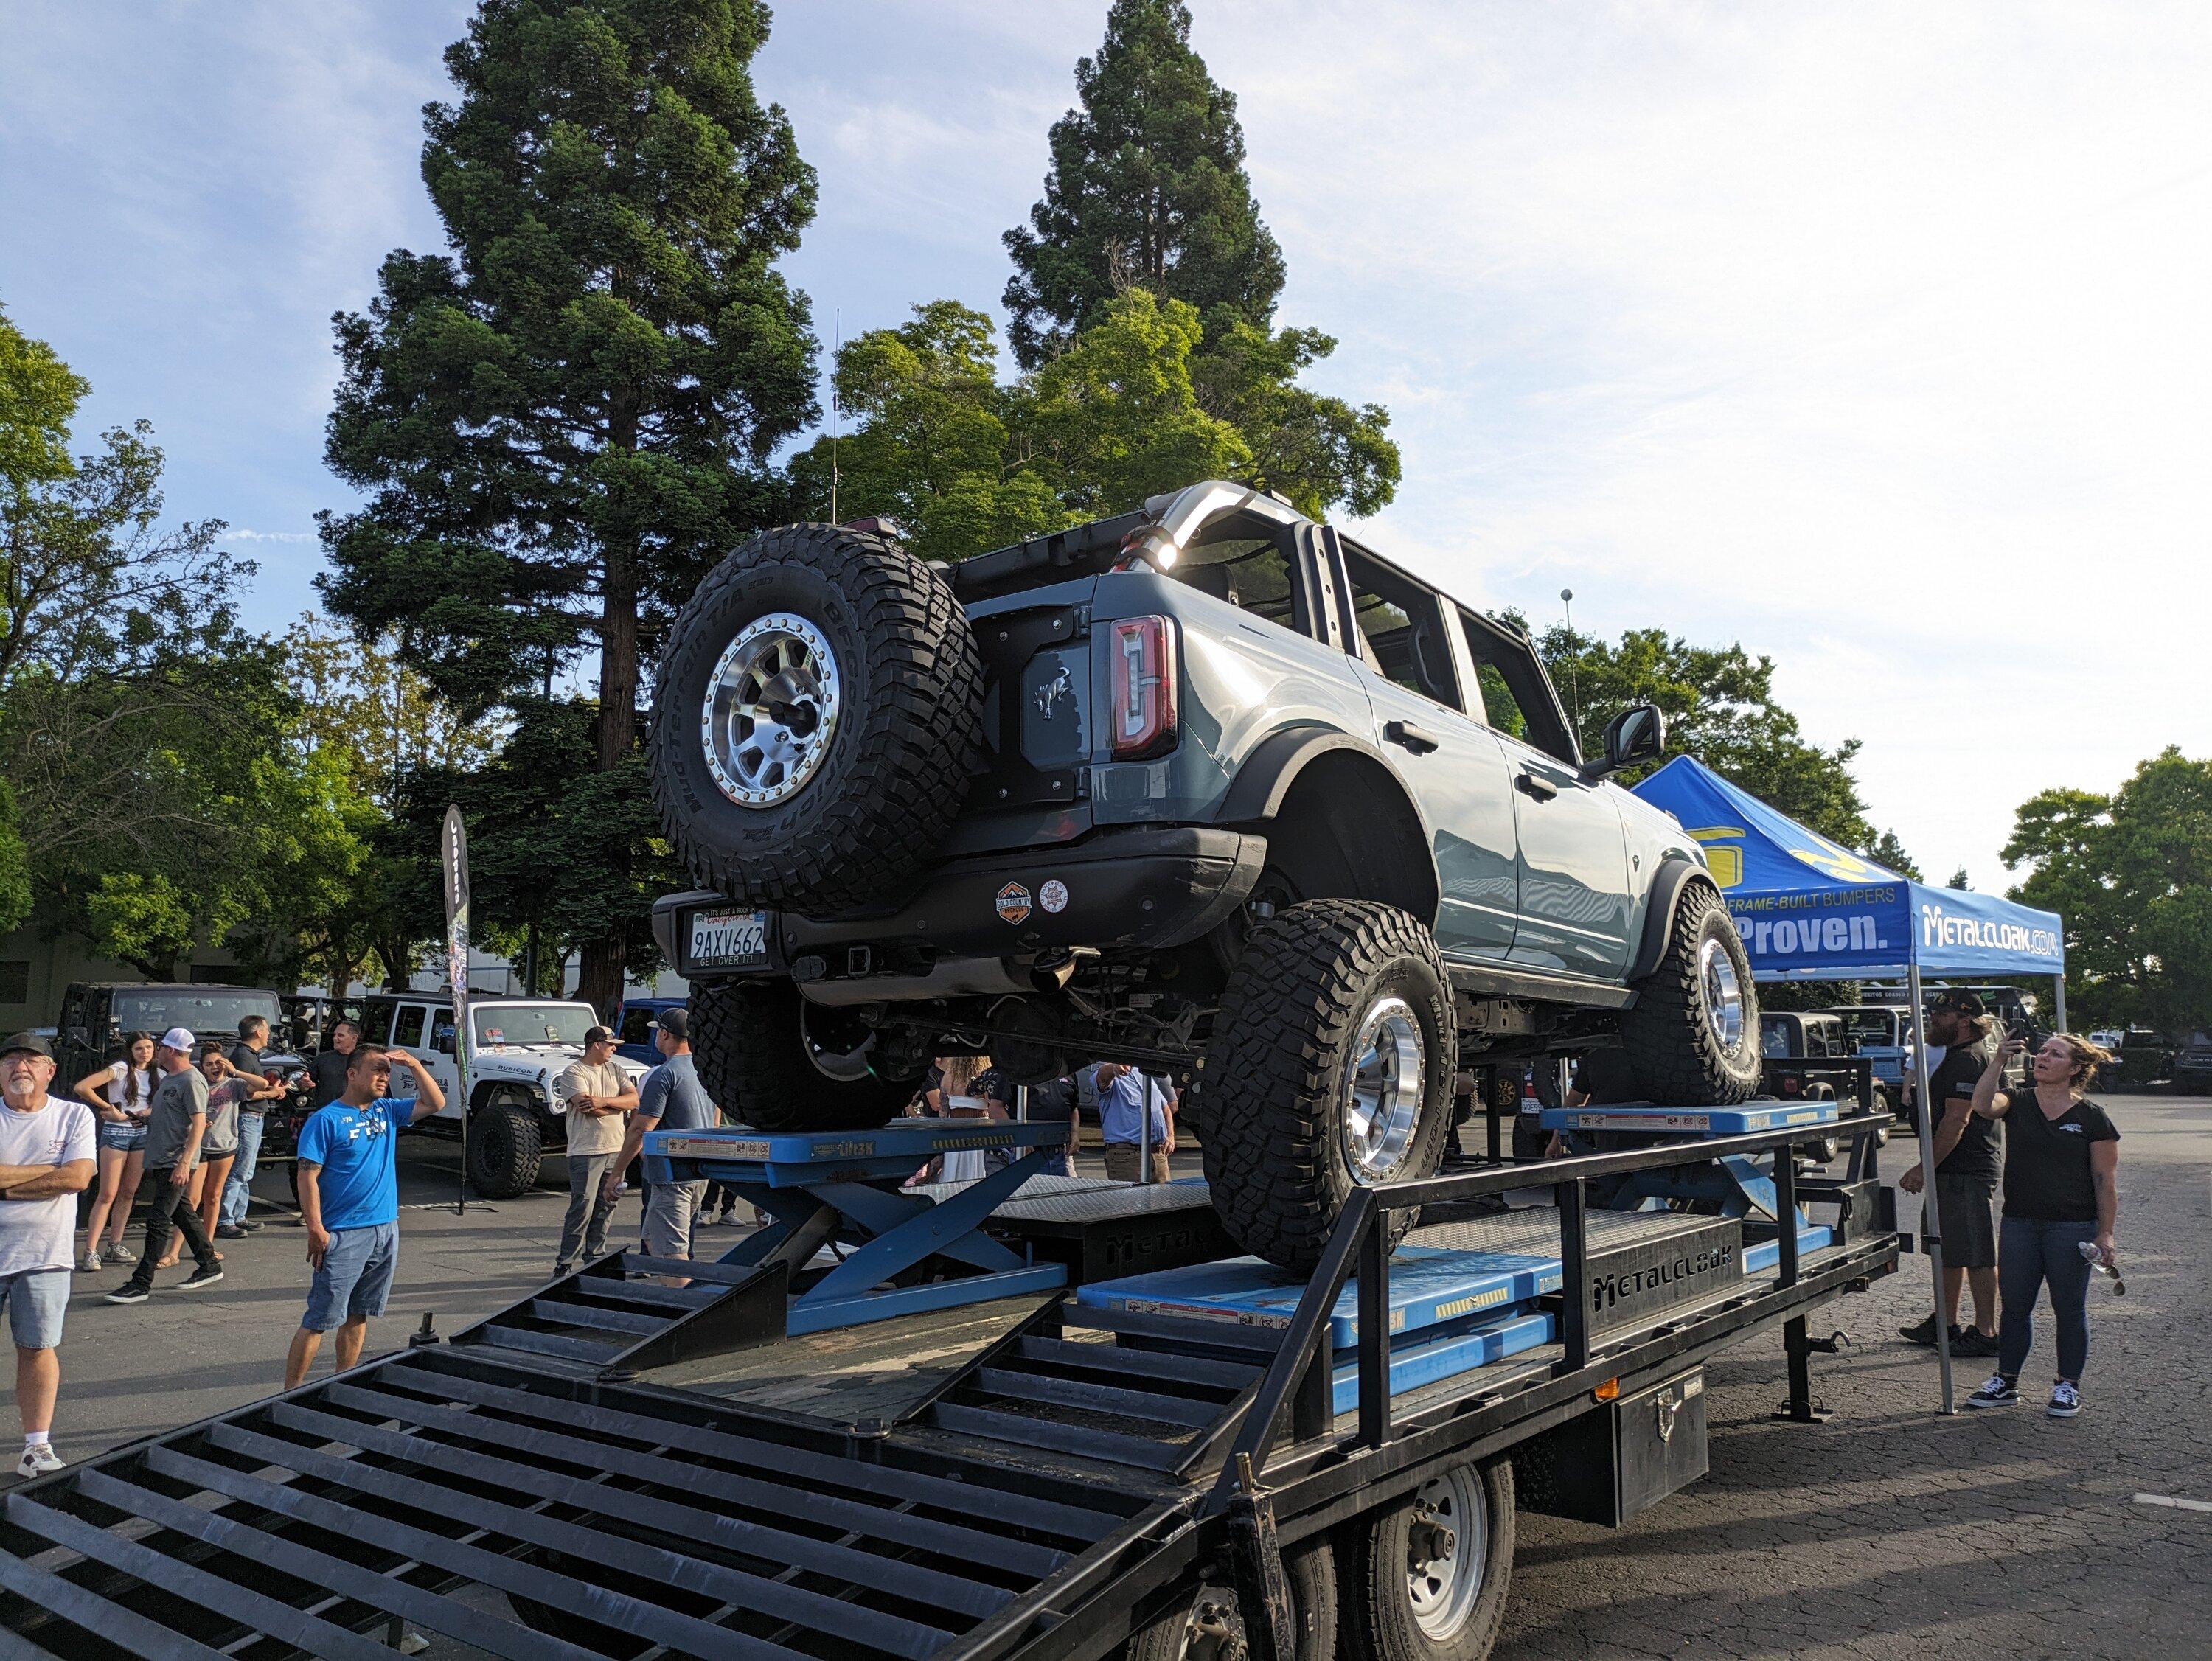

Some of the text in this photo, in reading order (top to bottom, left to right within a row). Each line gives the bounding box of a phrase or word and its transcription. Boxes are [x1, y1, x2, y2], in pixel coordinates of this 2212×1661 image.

[997, 897, 1031, 908] GOLD COUNTRY
[1728, 887, 1896, 912] FRAME-BUILT BUMPERS
[693, 926, 763, 958] 9AXV662
[1731, 914, 1888, 955] Proven.
[700, 954, 754, 967] GET OVER IT!
[498, 1065, 533, 1074] RUBICON
